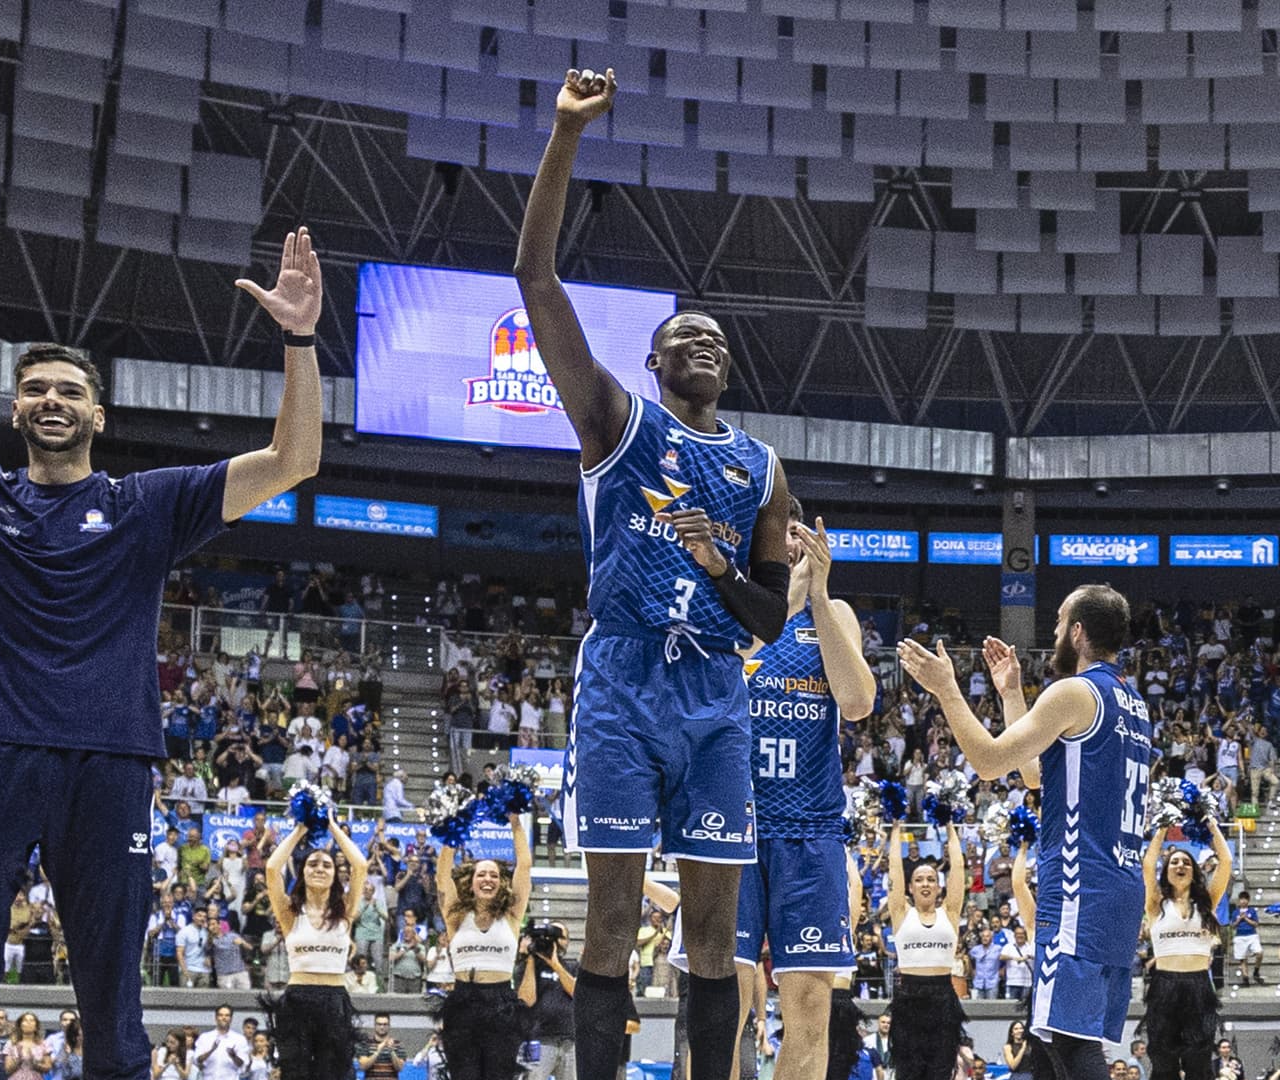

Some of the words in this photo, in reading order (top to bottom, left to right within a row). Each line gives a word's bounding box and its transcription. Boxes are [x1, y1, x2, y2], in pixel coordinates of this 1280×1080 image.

[472, 381, 564, 410] BURGO
[1195, 550, 1243, 559] ALFOZ
[668, 577, 697, 620] 3
[749, 700, 819, 720] URGOS
[759, 737, 797, 778] 59
[682, 828, 743, 843] LEXUS
[785, 943, 841, 953] LEXUS
